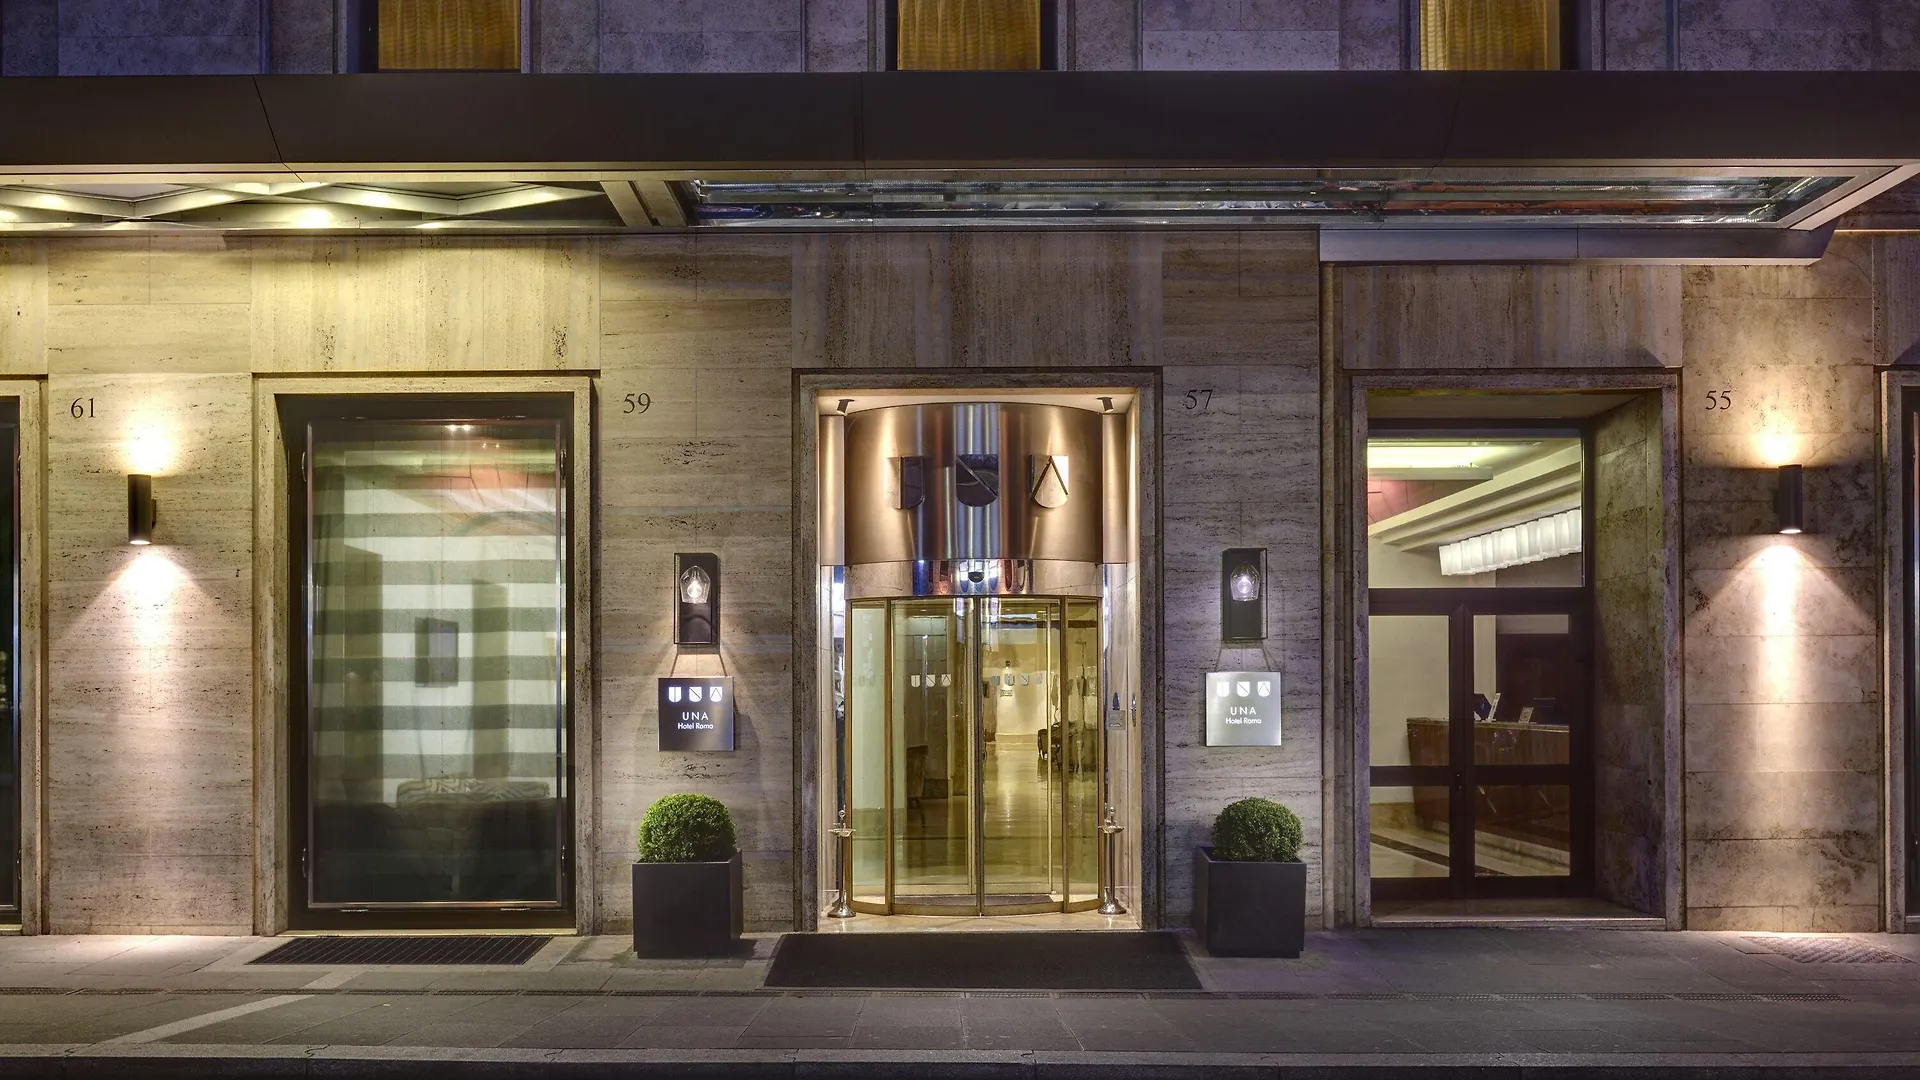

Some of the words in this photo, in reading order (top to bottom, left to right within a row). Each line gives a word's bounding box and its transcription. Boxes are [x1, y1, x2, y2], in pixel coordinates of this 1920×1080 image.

[70, 397, 96, 419] 61
[623, 392, 651, 414] 59
[1182, 389, 1213, 410] 57
[1705, 390, 1731, 410] 55
[682, 711, 709, 720] UNA
[1230, 706, 1257, 715] UNA
[677, 722, 694, 730] Hotel
[695, 722, 714, 730] Roma
